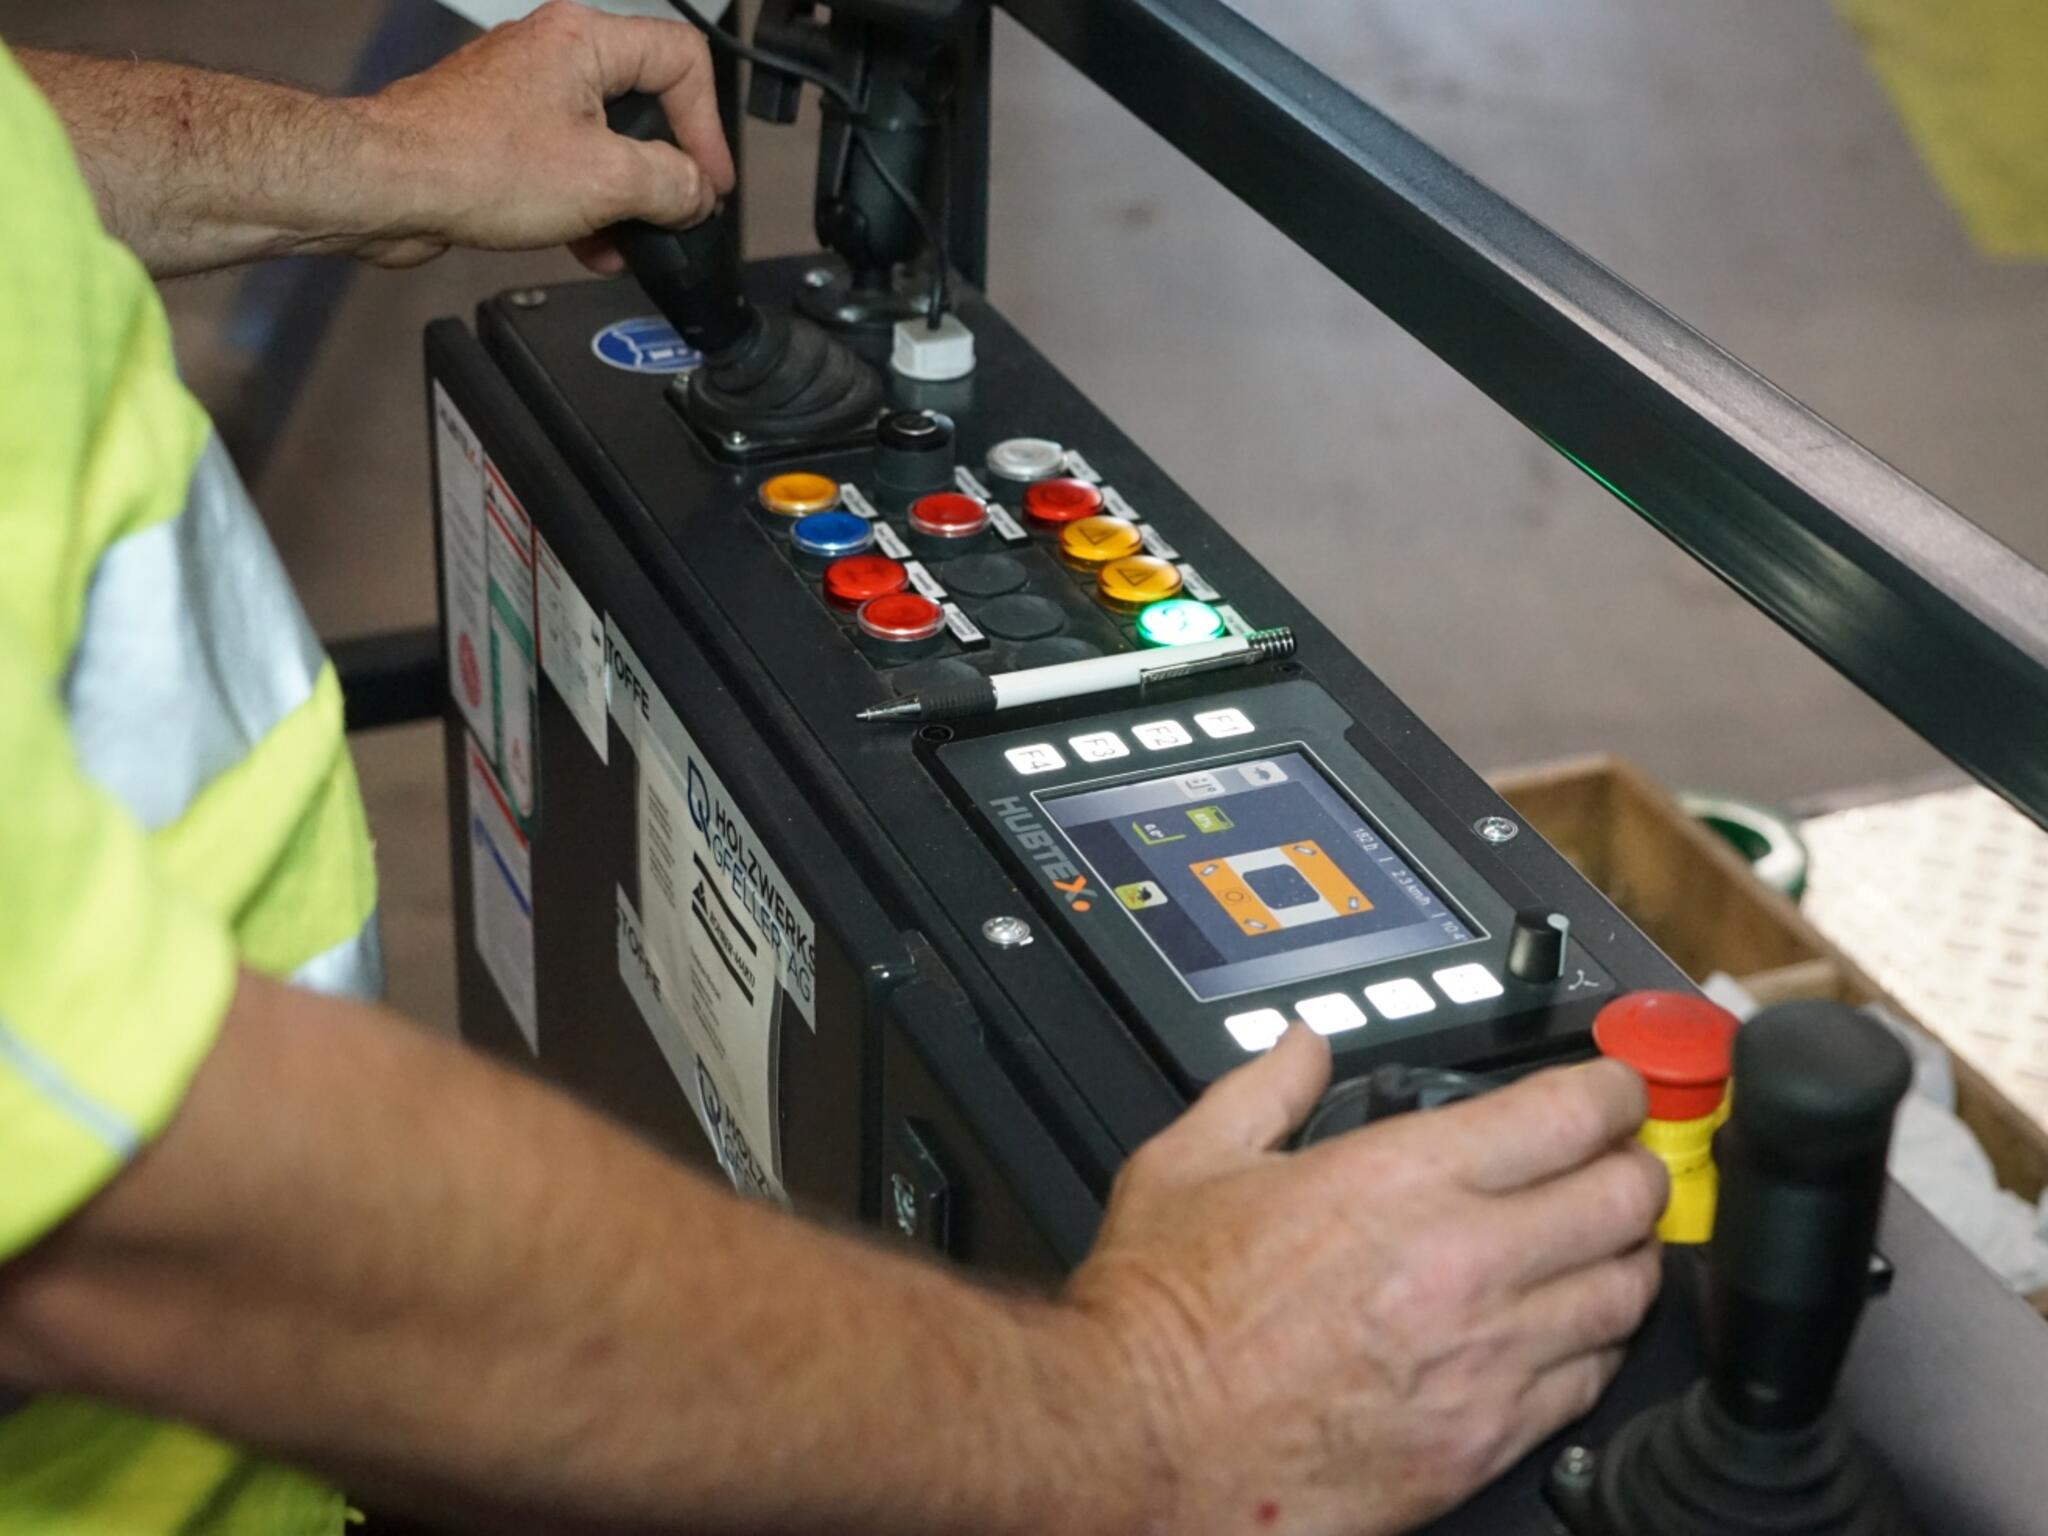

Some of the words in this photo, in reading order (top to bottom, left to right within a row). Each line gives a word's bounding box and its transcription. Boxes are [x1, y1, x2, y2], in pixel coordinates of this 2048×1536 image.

[1207, 714, 1240, 733] F1
[1146, 725, 1180, 746] F2
[1083, 737, 1116, 758] F3
[1018, 749, 1052, 769] F4
[712, 833, 782, 962] GFELLER
[787, 949, 811, 1003] AG
